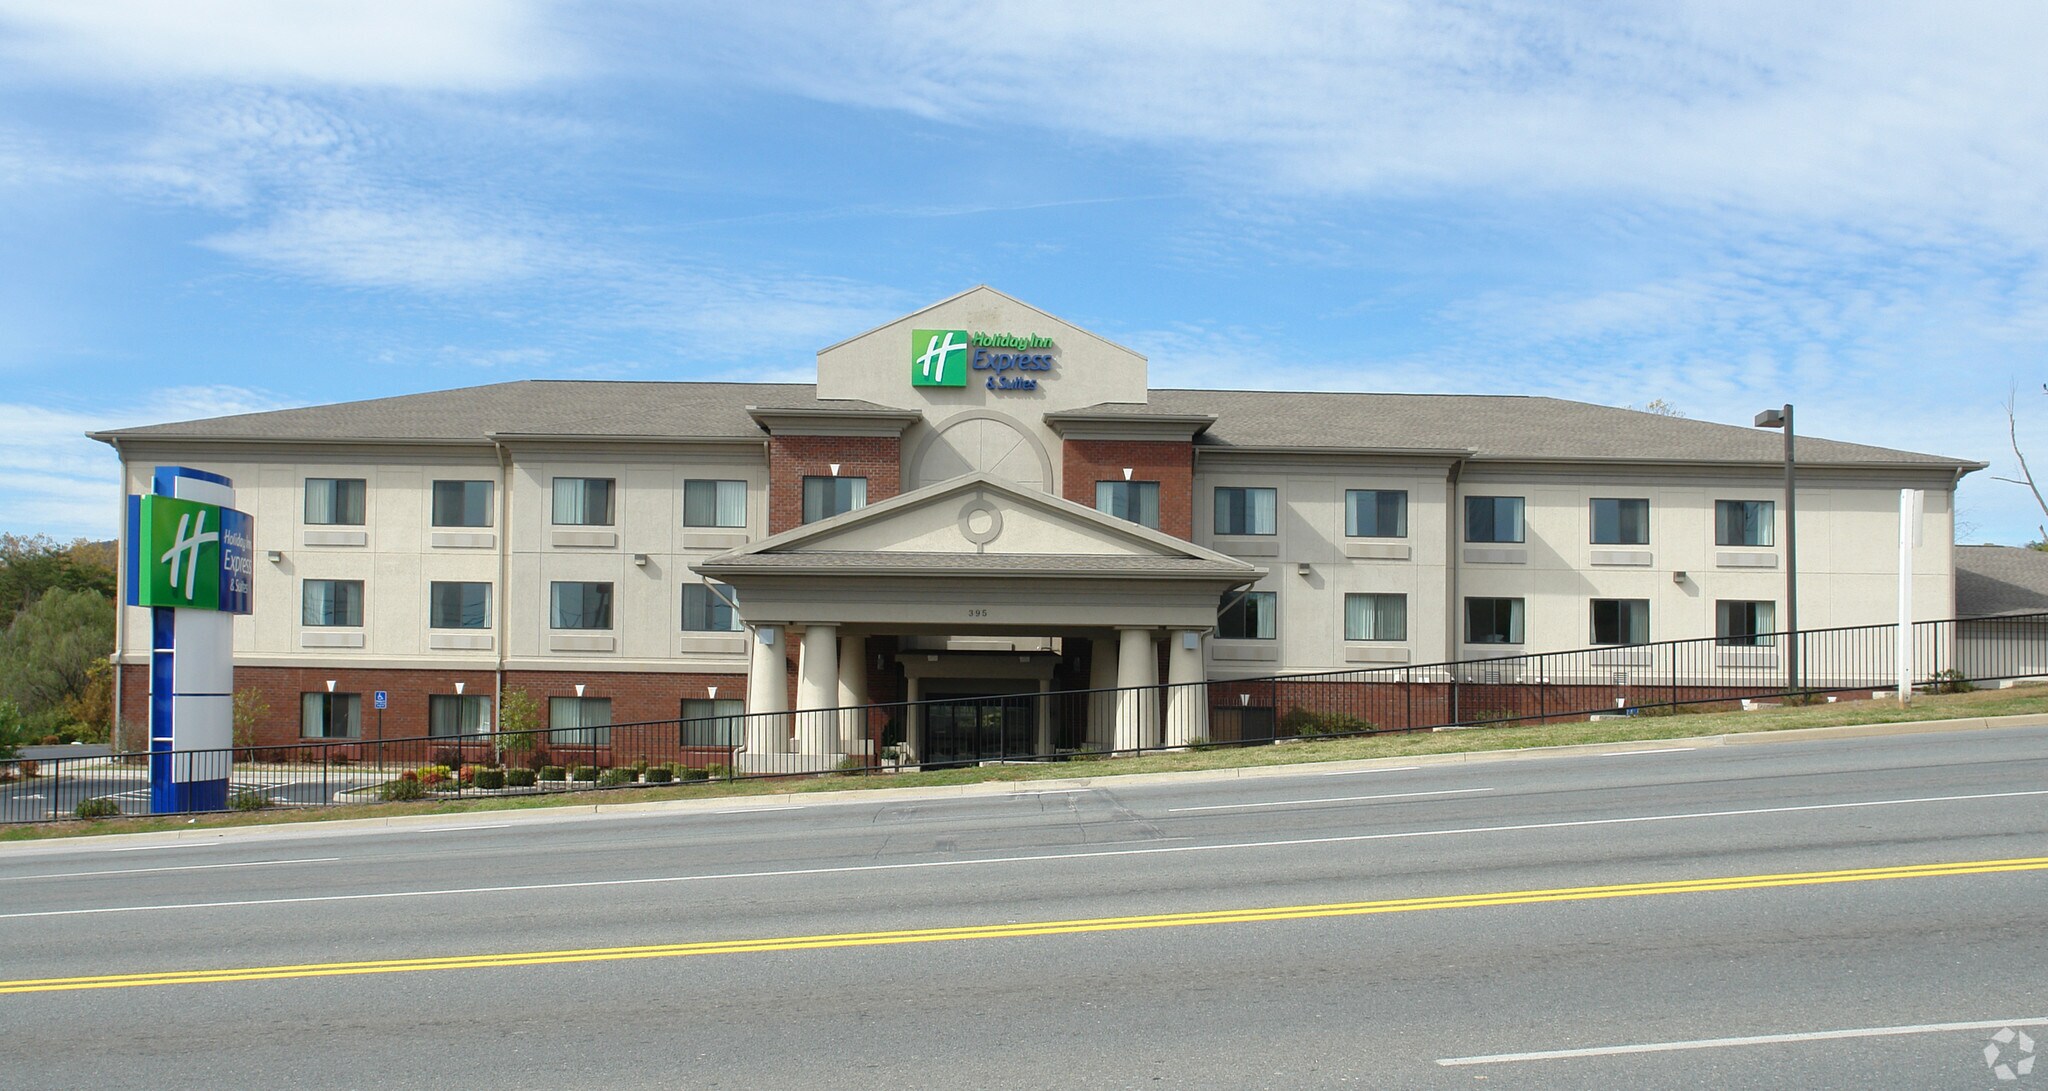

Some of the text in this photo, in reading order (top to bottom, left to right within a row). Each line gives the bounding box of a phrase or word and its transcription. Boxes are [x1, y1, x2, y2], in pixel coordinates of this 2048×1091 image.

[972, 331, 1053, 351] Holiday Inn
[973, 348, 1053, 375] Express
[986, 376, 1037, 390] & Suites
[224, 528, 246, 551] Holiday
[224, 549, 252, 577] Express
[968, 609, 987, 617] 395
